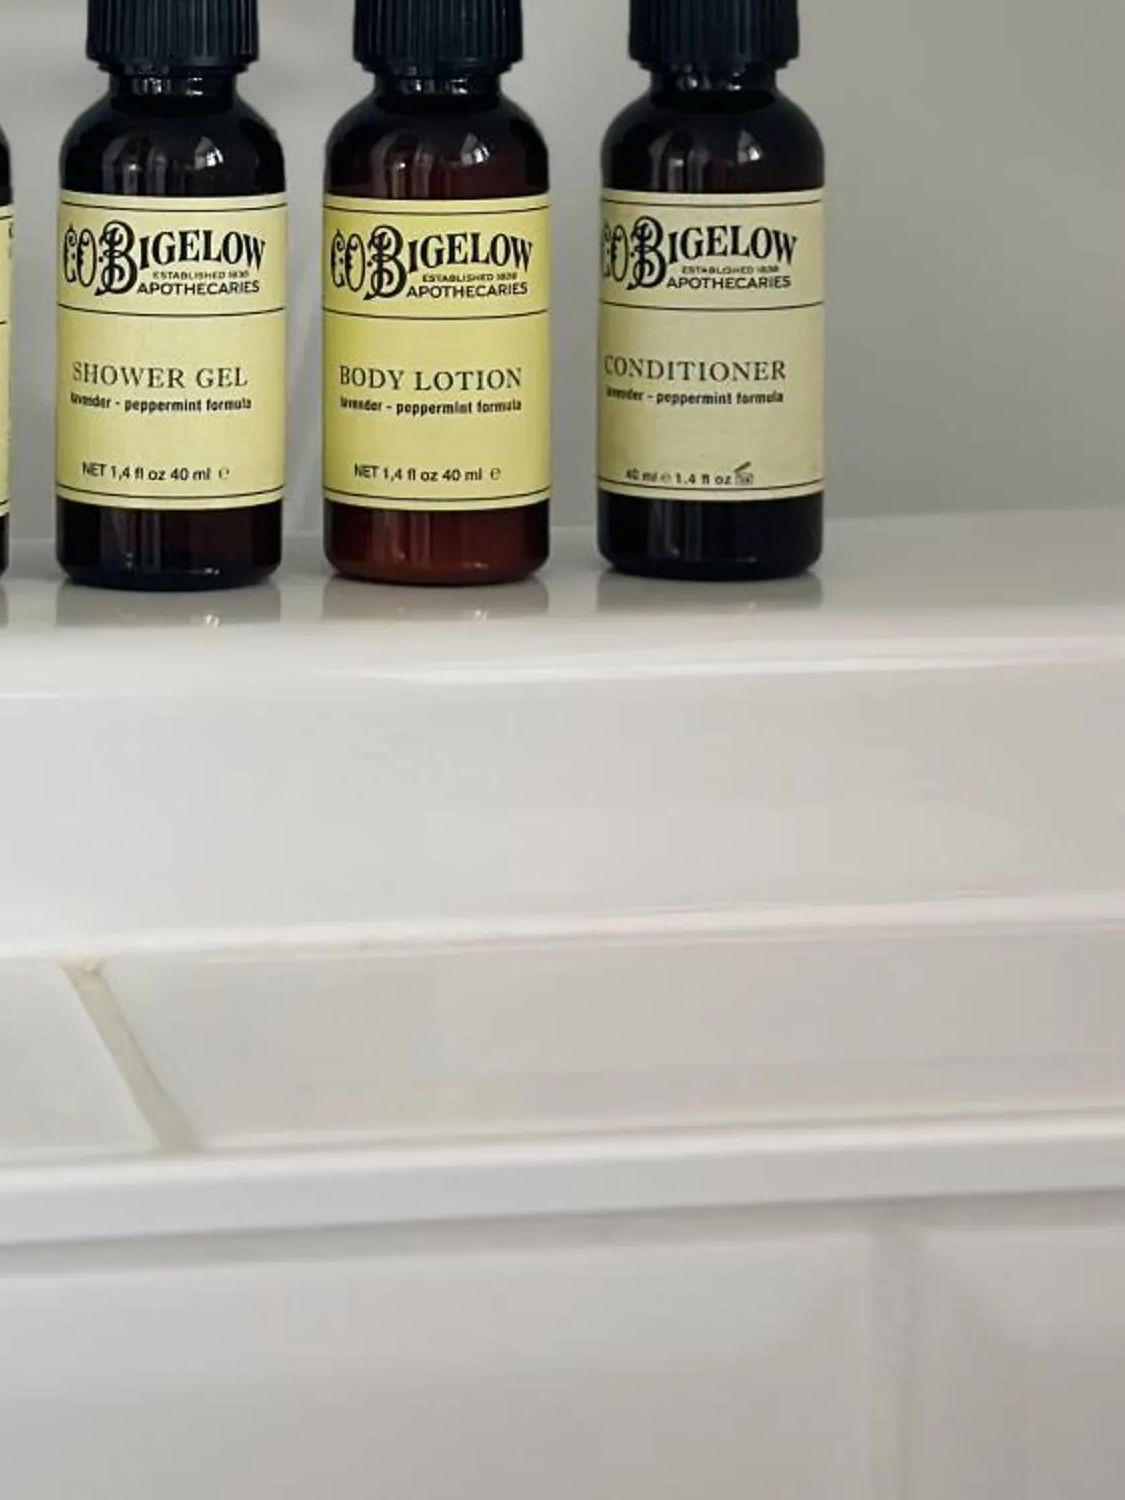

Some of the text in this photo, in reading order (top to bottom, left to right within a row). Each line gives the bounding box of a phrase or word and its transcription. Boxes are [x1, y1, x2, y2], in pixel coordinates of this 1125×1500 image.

[94, 220, 265, 296] BIGELOW
[626, 215, 798, 291] BIGELOW
[363, 224, 533, 301] BIGELOW
[682, 265, 754, 275] ESTABLISHED
[153, 271, 225, 280] ESTABLISHED
[422, 273, 494, 283] ESTABLISHED
[666, 275, 791, 289] APOTHECARIES
[137, 280, 260, 296] APOTHECARIES
[406, 282, 528, 298] APOTHECARIES
[72, 361, 248, 389] SHOWER GEL
[604, 355, 786, 382] CONDITIONER
[339, 365, 522, 391] BODY LOTION
[125, 399, 202, 414] peppermint
[206, 398, 252, 411] formula
[396, 400, 472, 417] peppermint
[477, 398, 522, 411] formula
[656, 391, 732, 407] peppermint
[737, 390, 784, 404] formula
[82, 461, 106, 477] NET
[135, 467, 144, 479] fl
[148, 470, 165, 481] oz
[170, 468, 188, 481] 40
[192, 467, 211, 481] ml
[354, 463, 379, 478] NET
[407, 468, 416, 481] fl
[420, 470, 438, 482] oz
[442, 468, 461, 482] 40
[464, 467, 482, 481] ml
[626, 468, 639, 481] 40
[642, 470, 658, 483] ml
[676, 472, 696, 485] 1.4
[715, 474, 732, 485] oz
